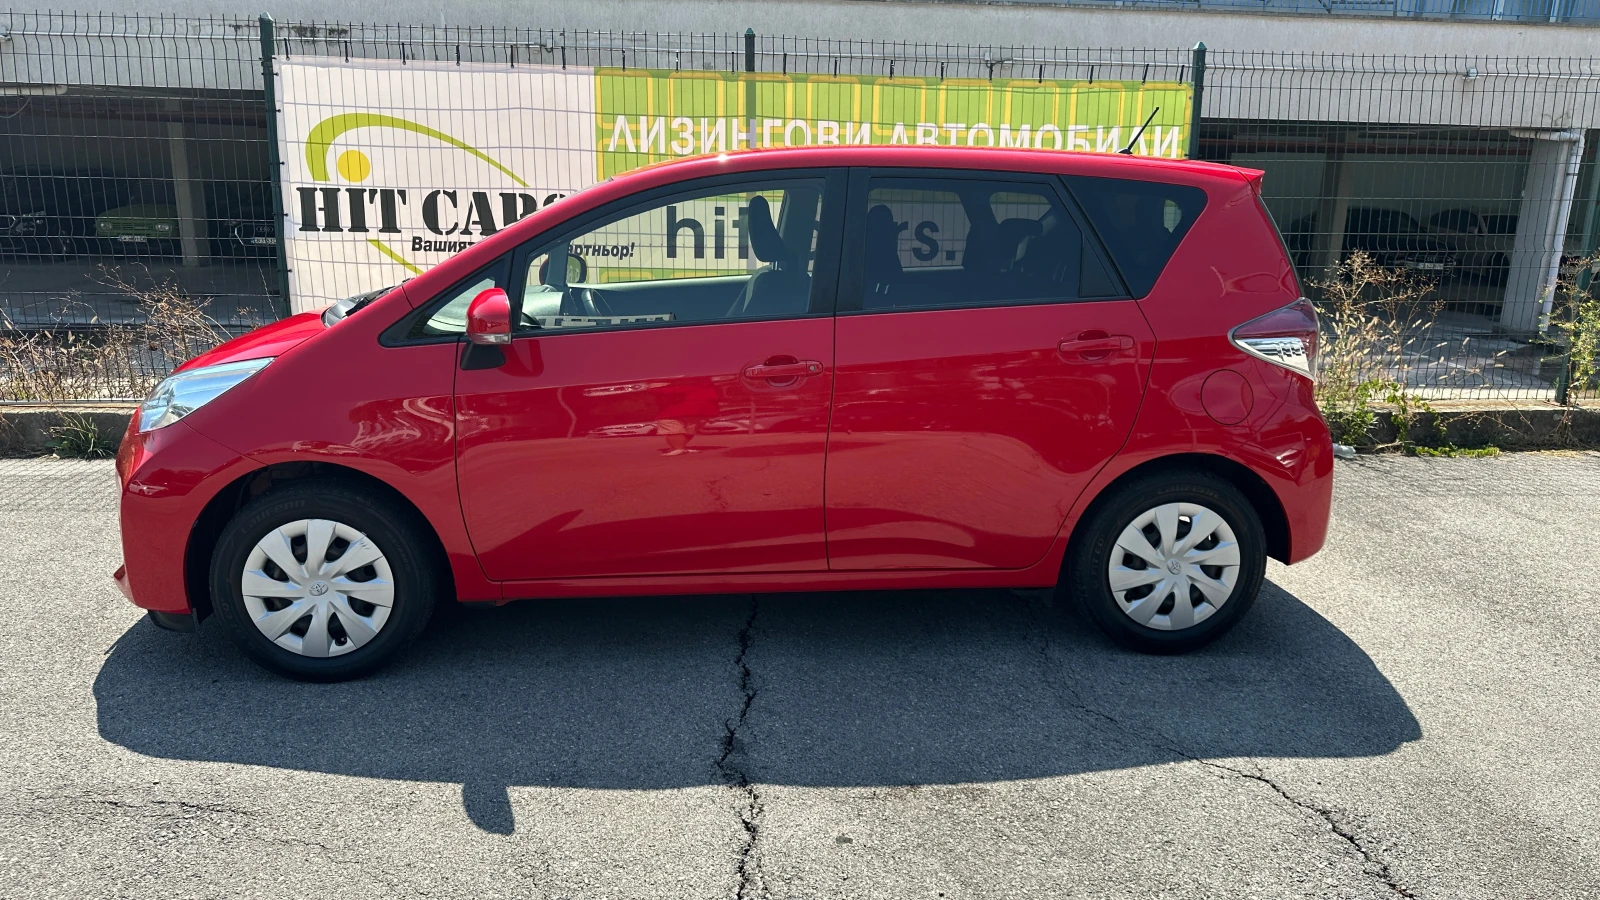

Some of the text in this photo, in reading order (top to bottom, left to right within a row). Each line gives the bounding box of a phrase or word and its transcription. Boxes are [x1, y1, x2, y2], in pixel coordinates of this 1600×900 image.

[608, 115, 1179, 158] ЛИЗИНГОВИ АВТОМОБИЛИ
[296, 187, 566, 236] HIT CAR
